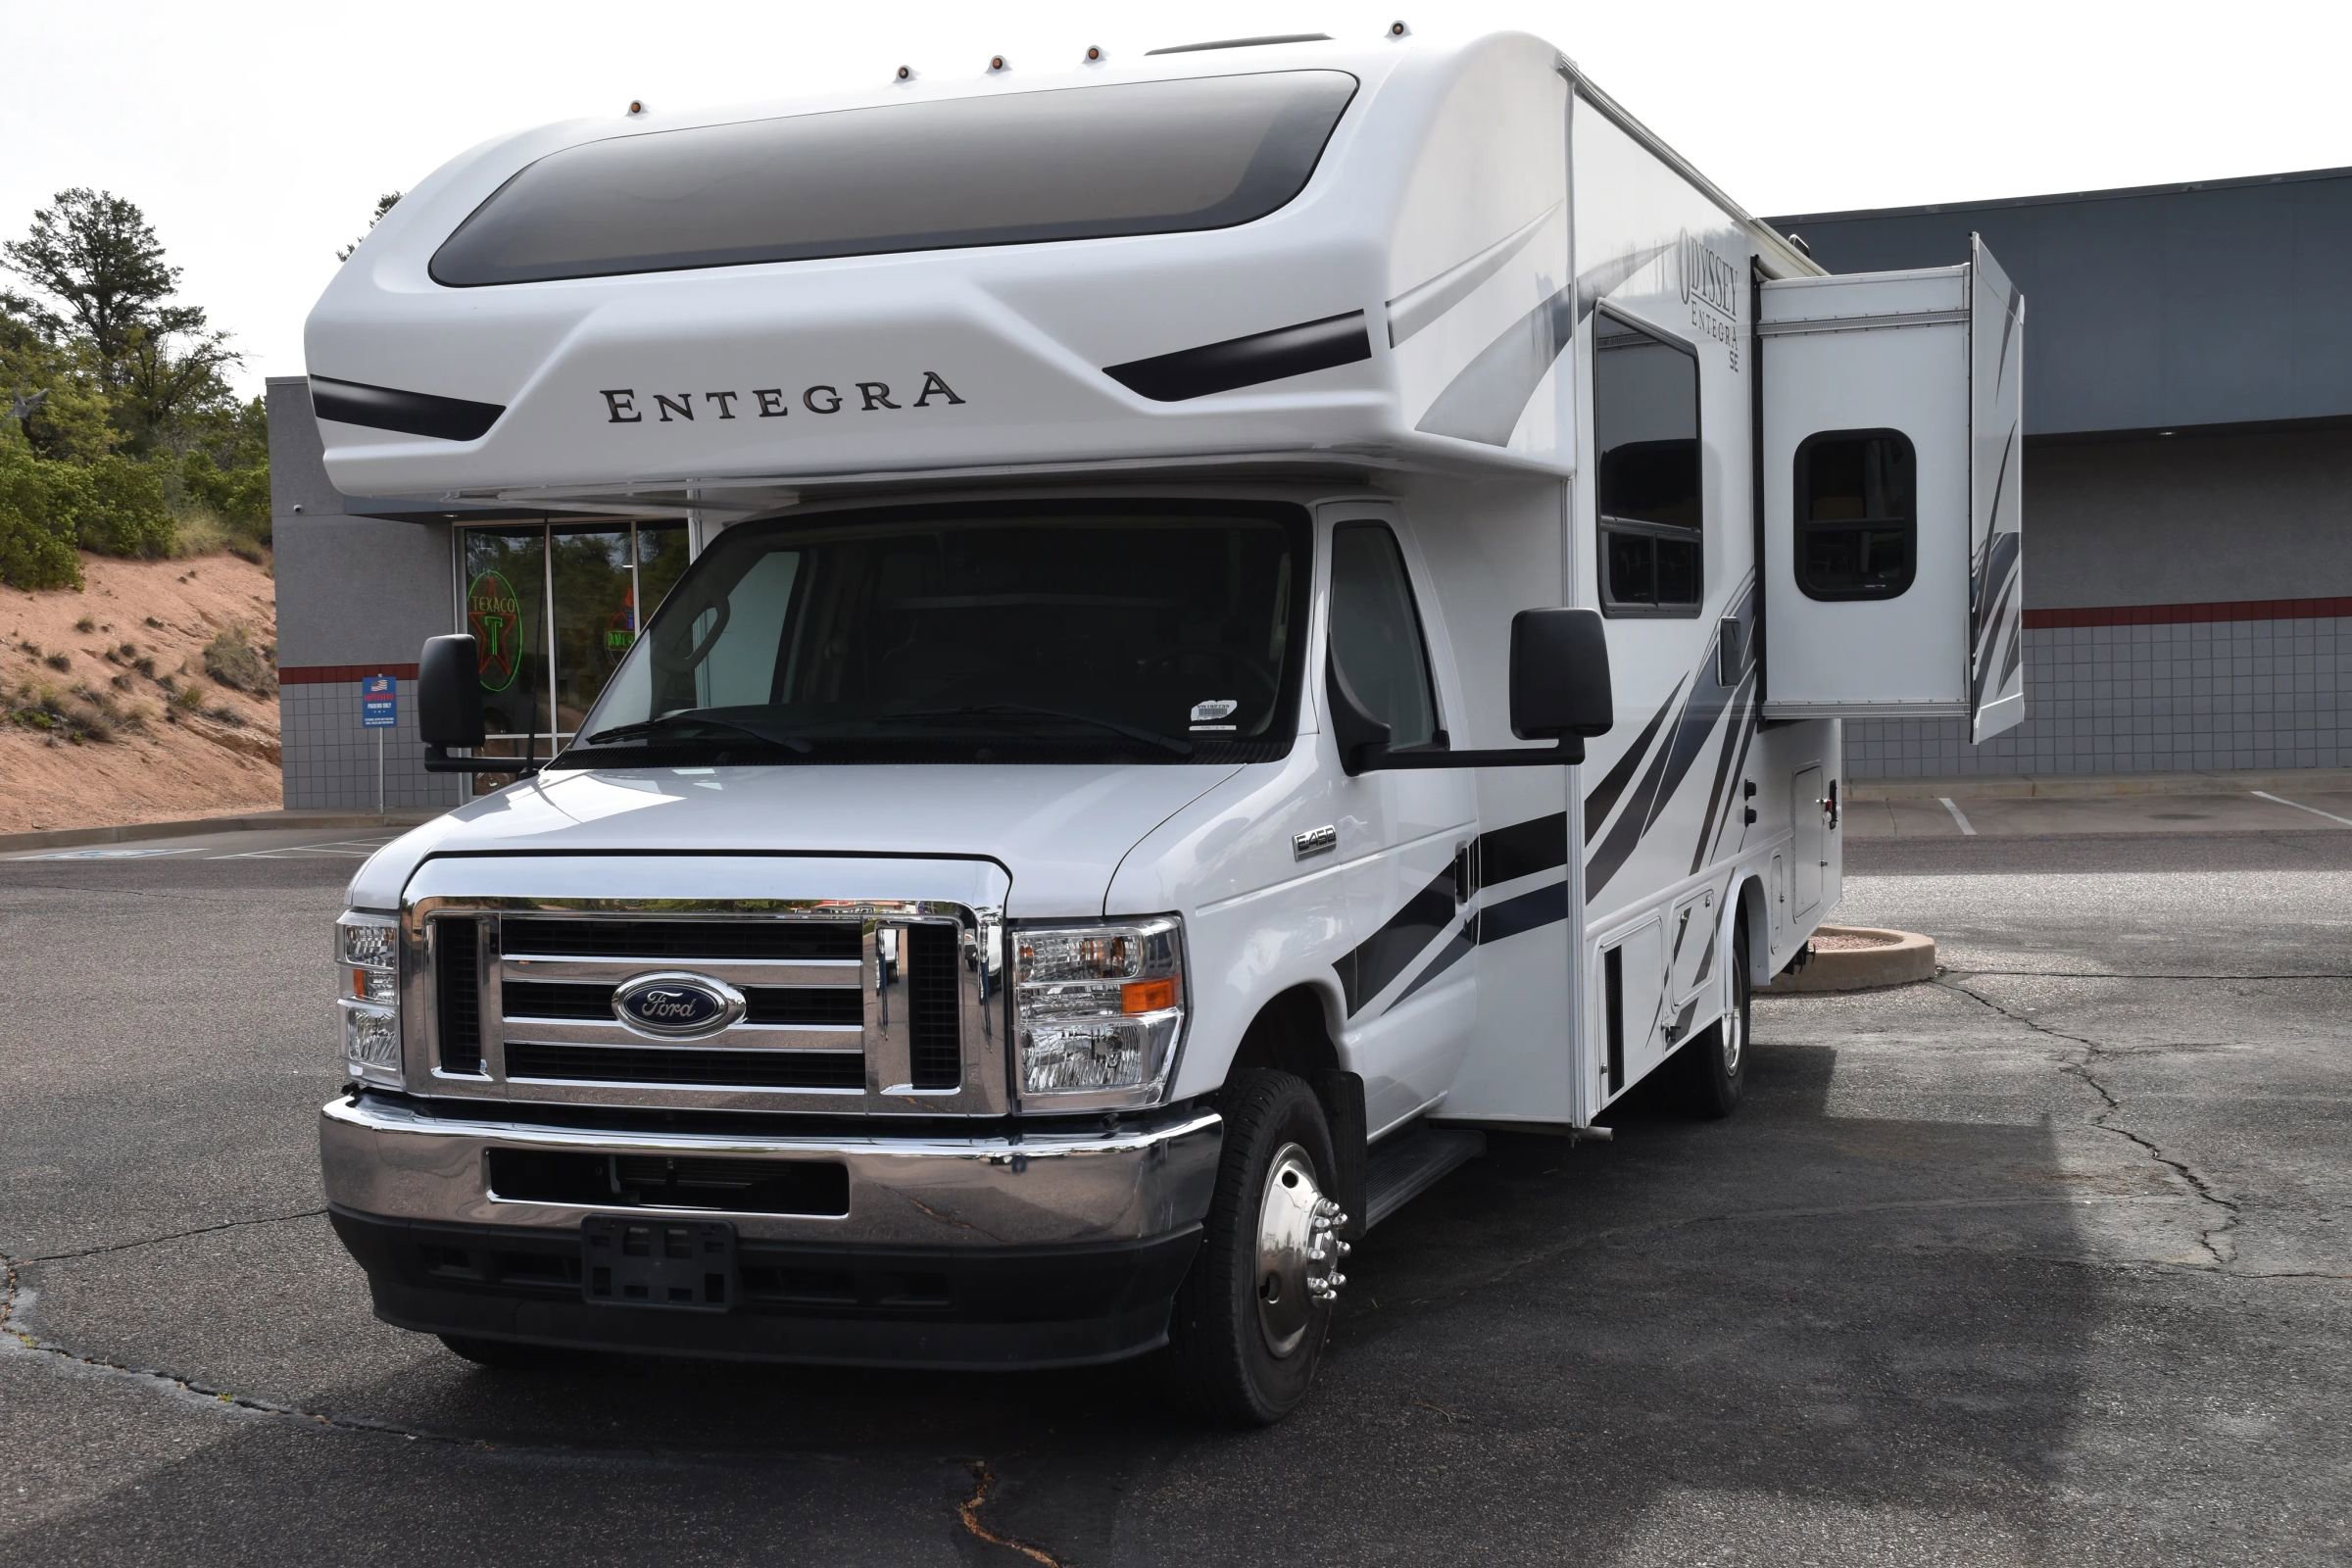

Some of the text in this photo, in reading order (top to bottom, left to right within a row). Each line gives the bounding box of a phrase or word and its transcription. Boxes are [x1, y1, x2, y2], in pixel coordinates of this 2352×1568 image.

[1679, 227, 1739, 317] ODYSSEY
[1690, 300, 1739, 351] ENTEGRA
[1729, 350, 1739, 372] SE
[599, 370, 966, 423] ENTEGRA
[470, 596, 515, 613] TEXACO
[484, 615, 503, 656] T
[1296, 827, 1336, 851] E-450
[641, 990, 698, 1017] Ford
